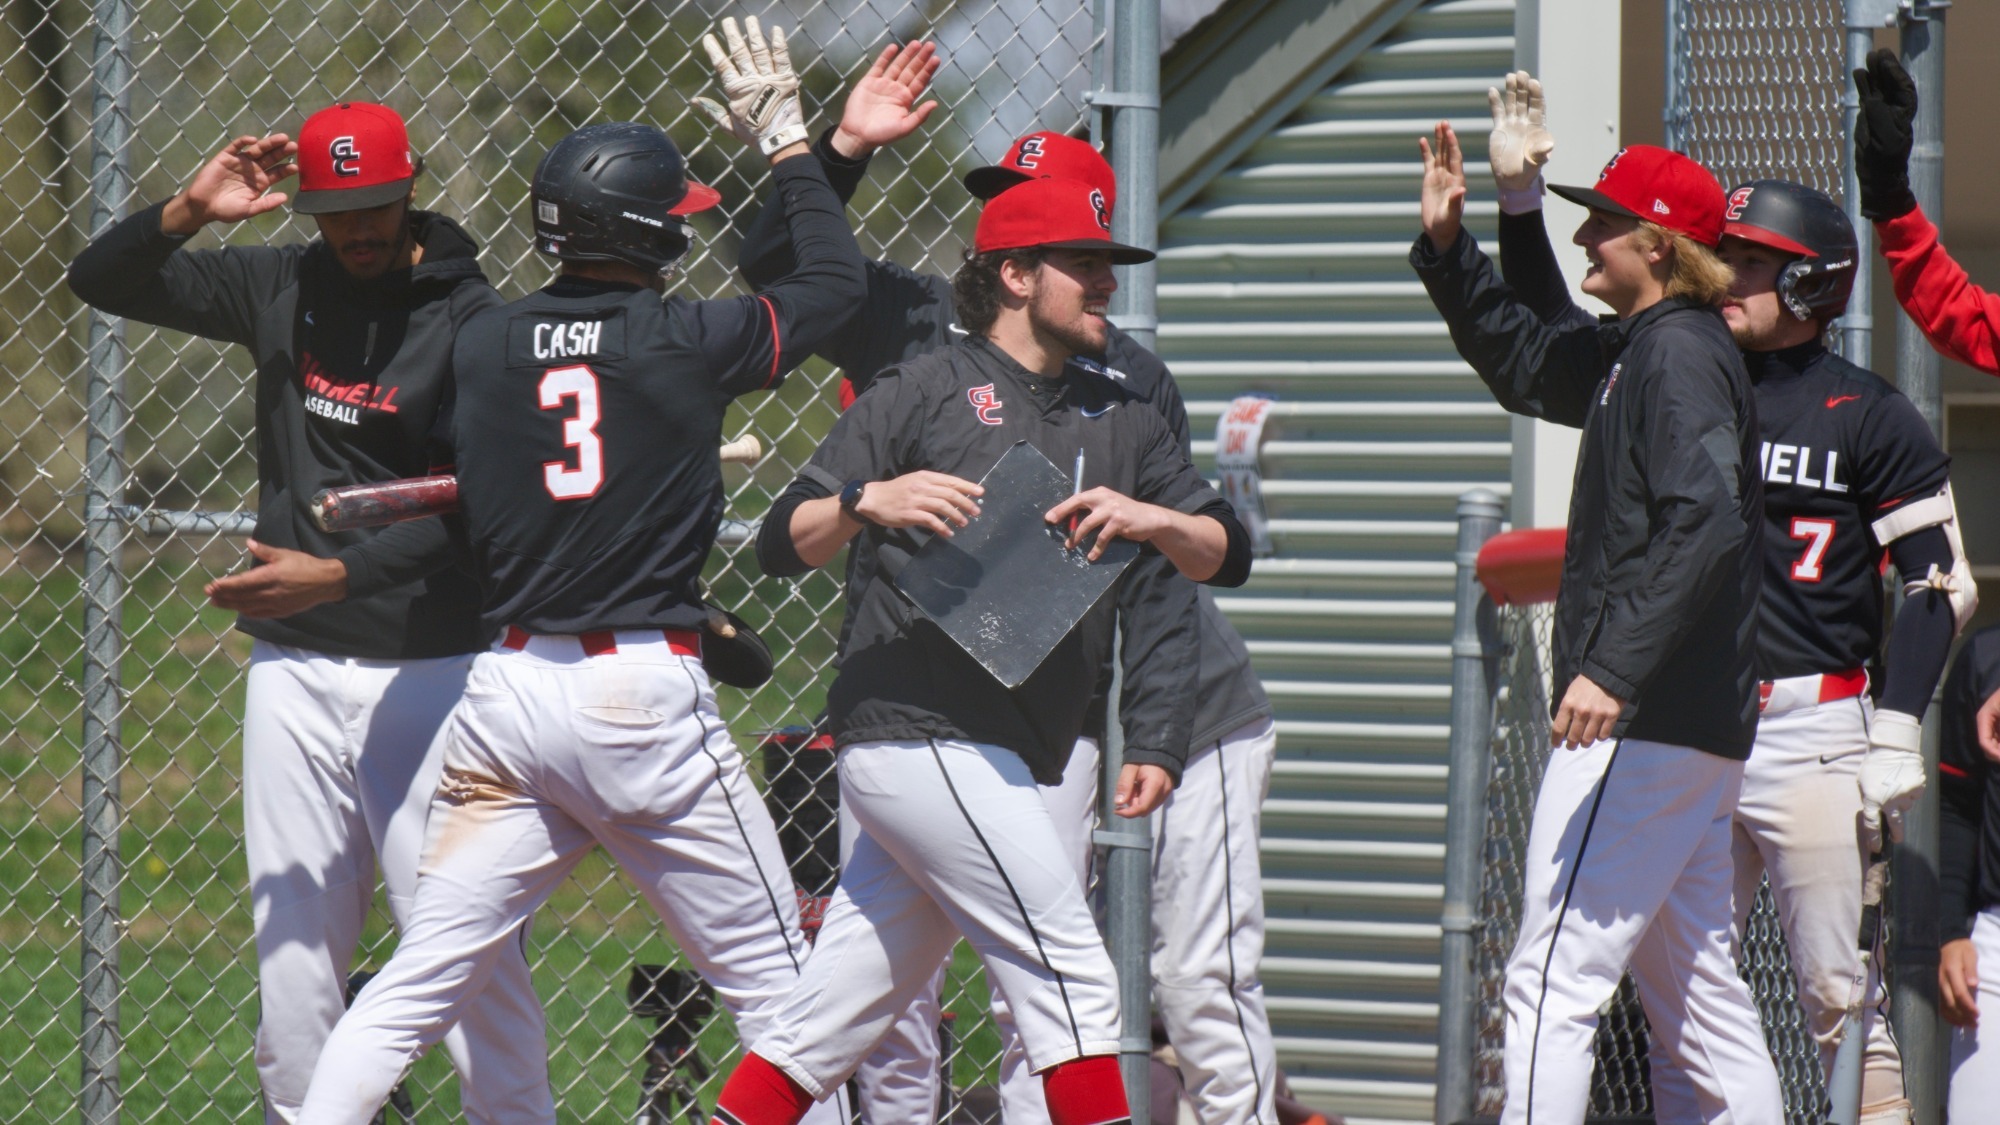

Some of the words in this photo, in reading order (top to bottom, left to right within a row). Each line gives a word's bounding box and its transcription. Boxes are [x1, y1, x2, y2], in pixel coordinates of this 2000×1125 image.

[534, 321, 602, 359] CASH
[304, 393, 359, 425] ASEBALL
[537, 363, 604, 501] 3
[1789, 516, 1836, 583] 7
